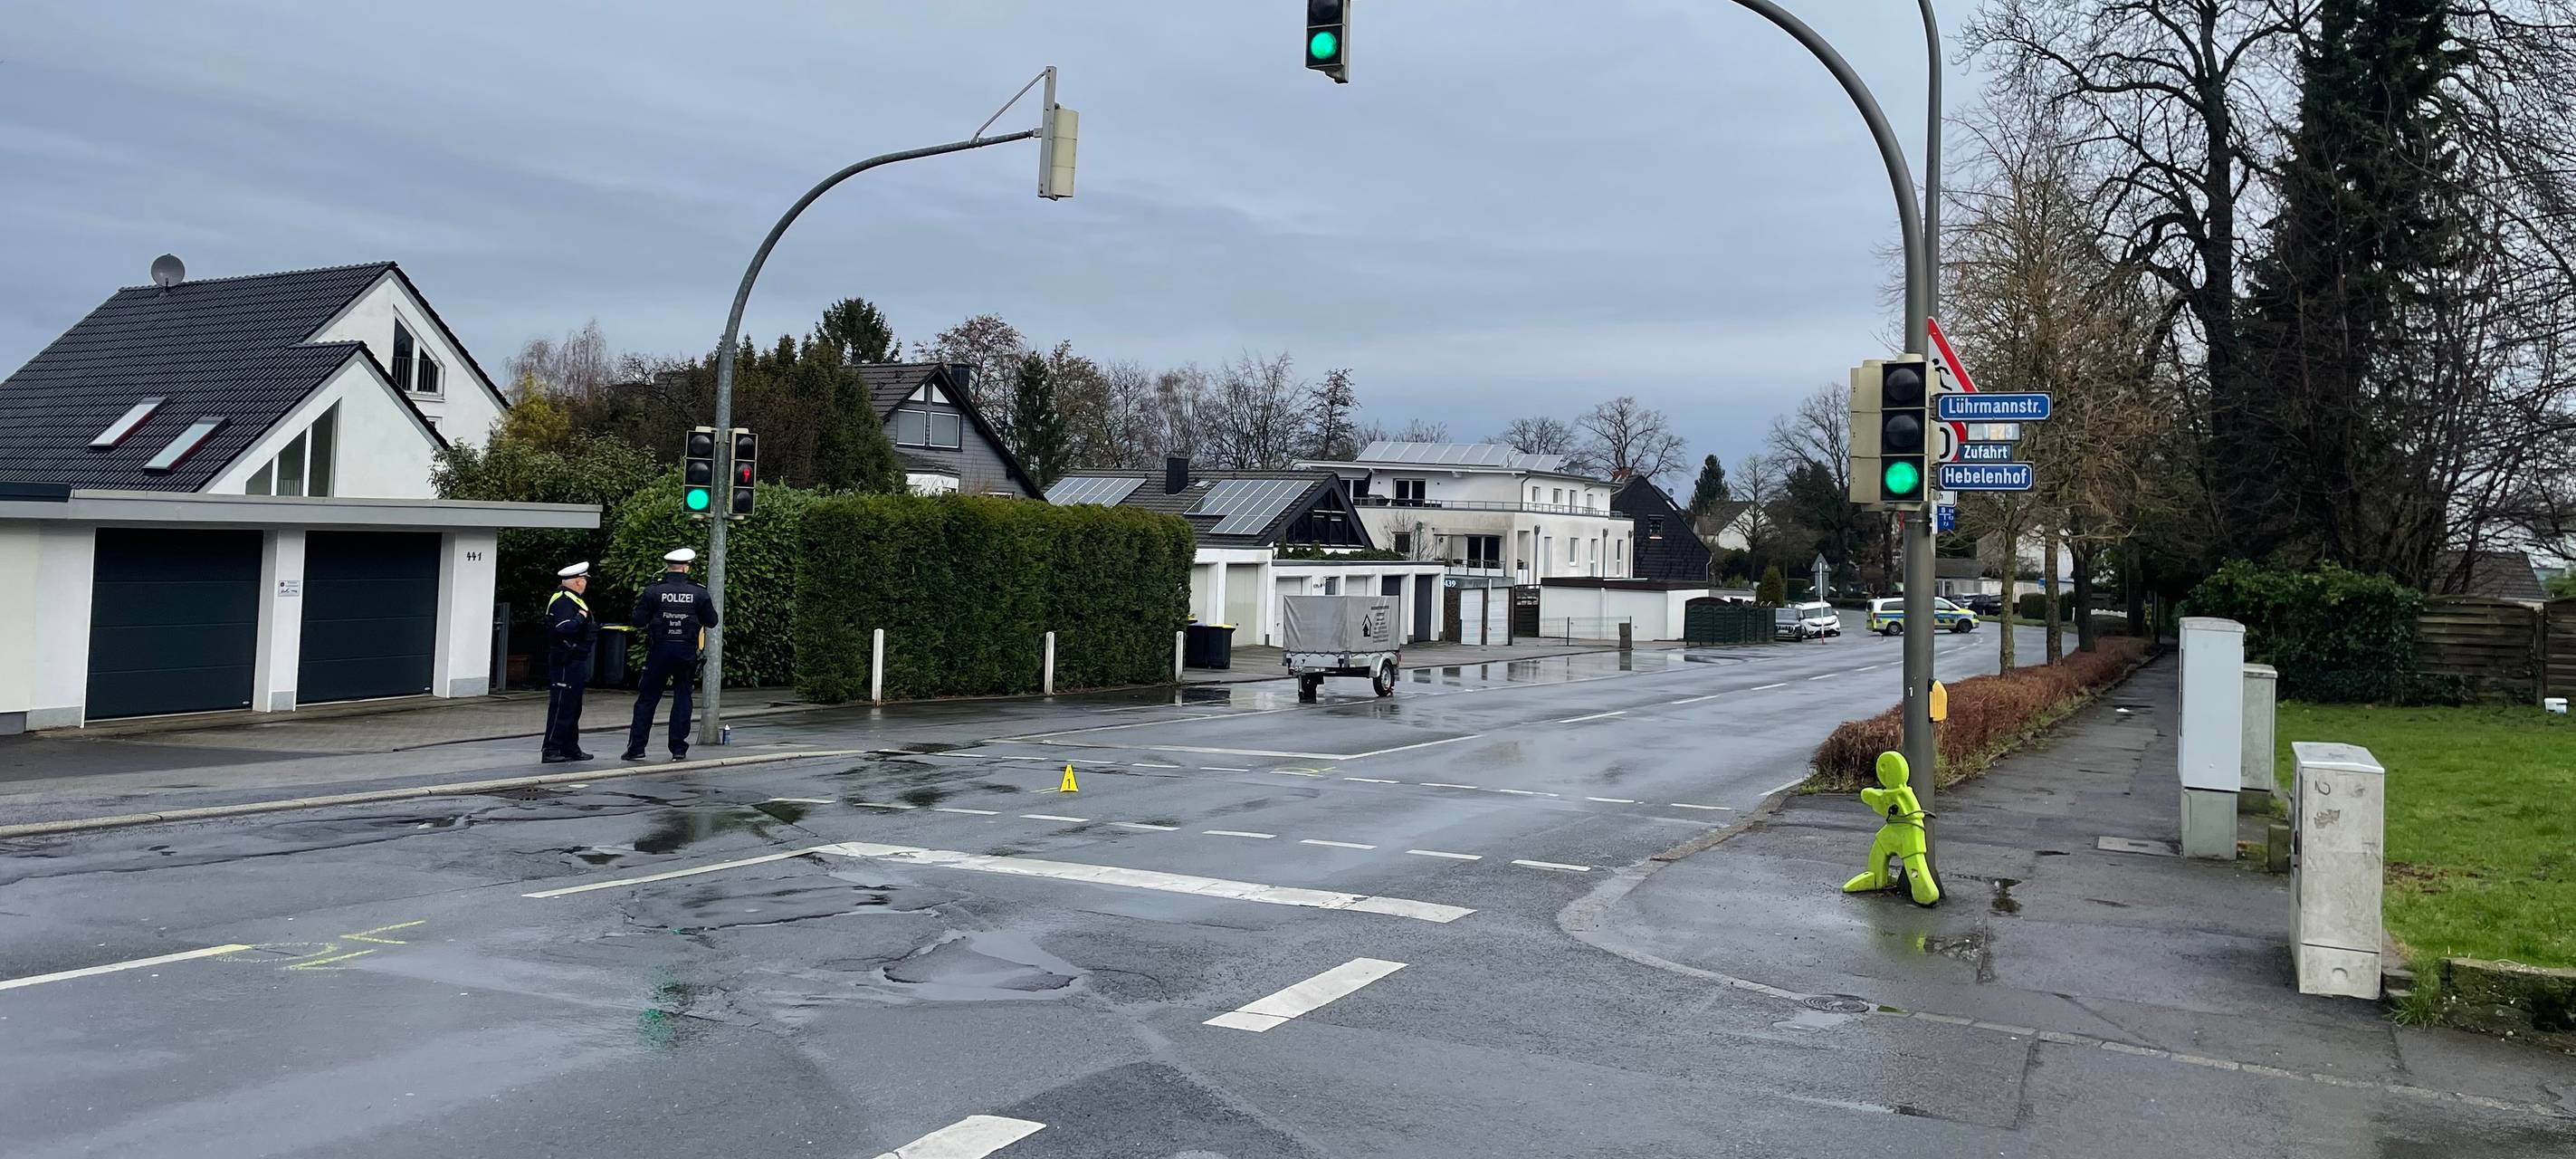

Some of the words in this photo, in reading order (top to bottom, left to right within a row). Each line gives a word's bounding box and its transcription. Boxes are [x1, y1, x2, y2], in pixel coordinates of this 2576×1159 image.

[1949, 398, 2041, 414] Lührmannstr.
[1964, 445, 2008, 459] Zufahrt
[1946, 467, 2027, 484] Hebelenhof
[466, 551, 482, 561] 441
[662, 593, 693, 603] POLIZEI
[1908, 686, 1913, 697] 1
[1066, 778, 1071, 790] 1
